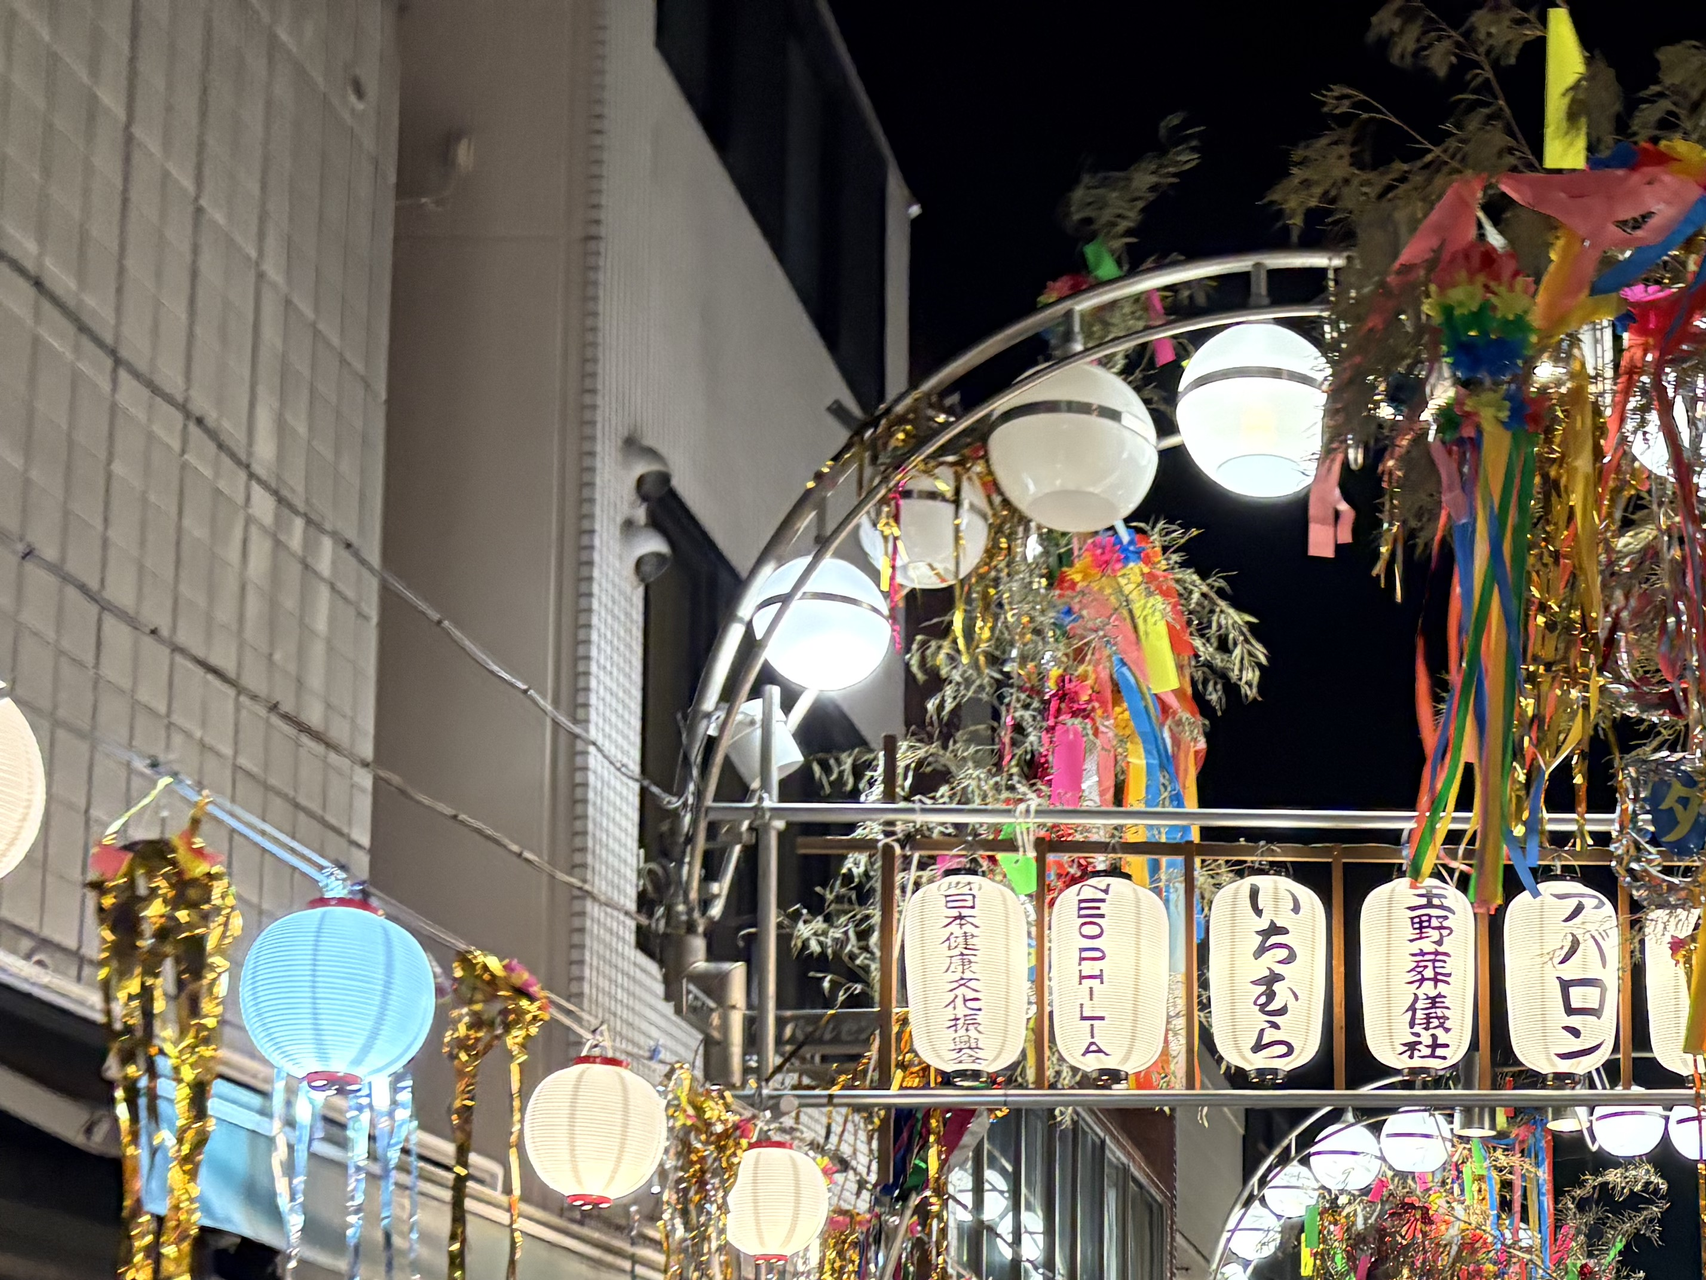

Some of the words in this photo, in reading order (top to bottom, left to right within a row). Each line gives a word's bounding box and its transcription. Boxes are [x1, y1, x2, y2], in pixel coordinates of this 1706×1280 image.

[1075, 883, 1111, 1057] NEOPHILIA
[1248, 882, 1300, 1060] いちむら
[1398, 886, 1456, 1060] 玉野葬儀社
